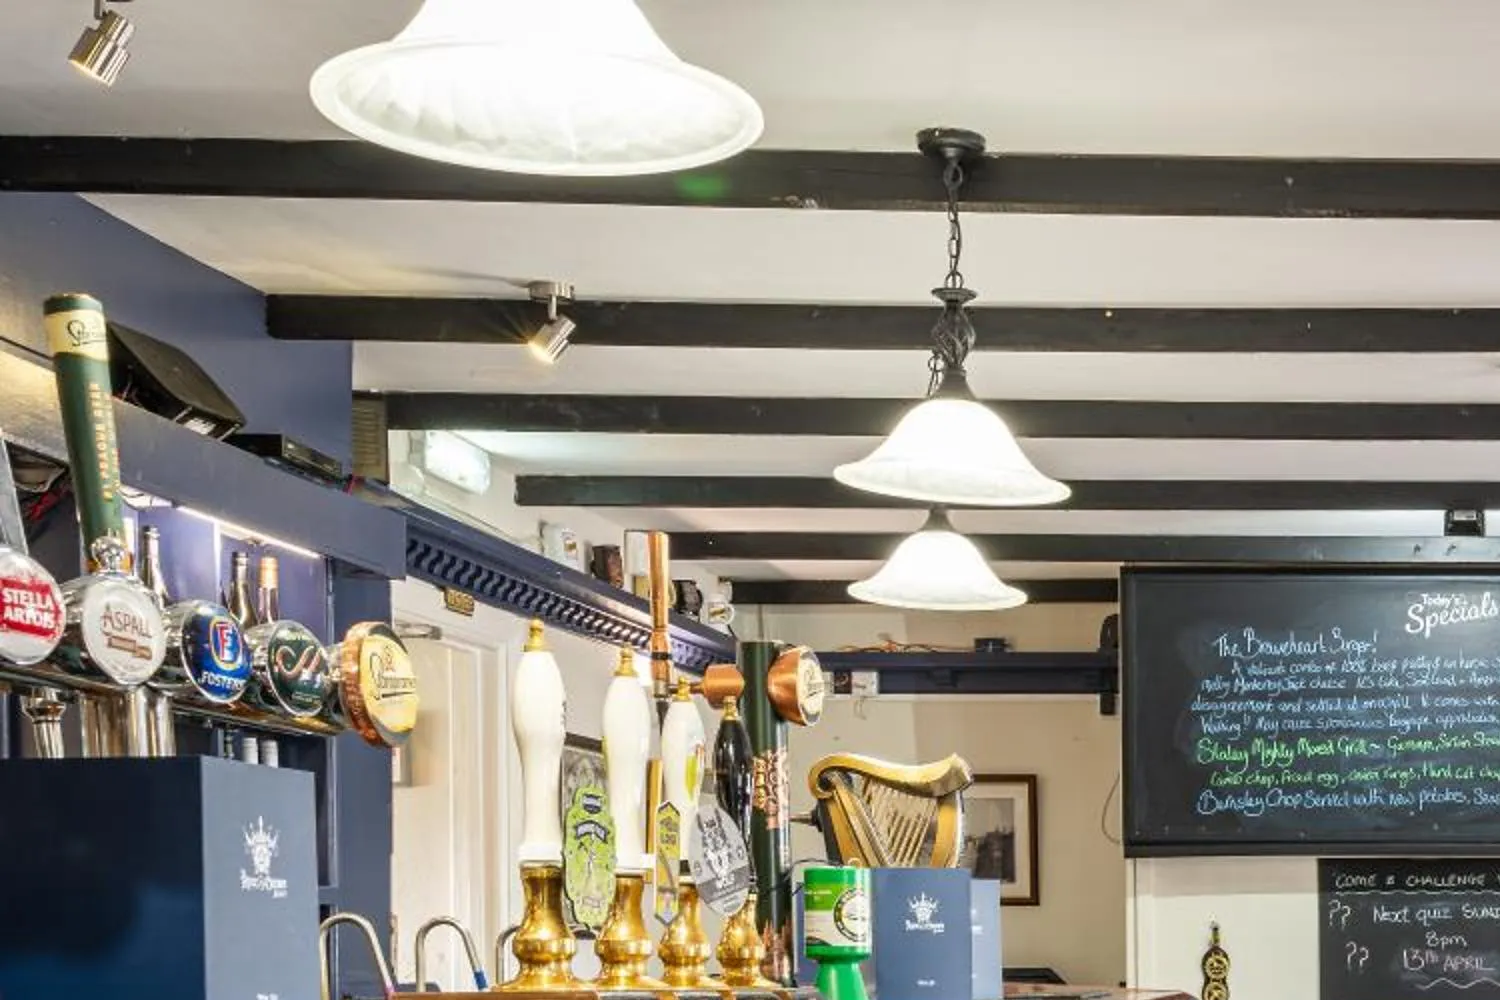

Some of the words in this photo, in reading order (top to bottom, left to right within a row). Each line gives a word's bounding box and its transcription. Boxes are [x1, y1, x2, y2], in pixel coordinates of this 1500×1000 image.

[3, 587, 51, 608] STELLA
[1420, 593, 1468, 607] Today's
[4, 606, 54, 628] ARTOIS
[101, 602, 152, 638] ASPALL
[1405, 592, 1499, 638] Specials
[1212, 634, 1238, 658] The
[1353, 788, 1384, 805] with
[1335, 874, 1376, 888] COME
[1405, 874, 1485, 887] CHALLENGE
[1373, 902, 1411, 924] Next
[1425, 931, 1467, 949] 8pm
[1443, 954, 1496, 972] APRIL
